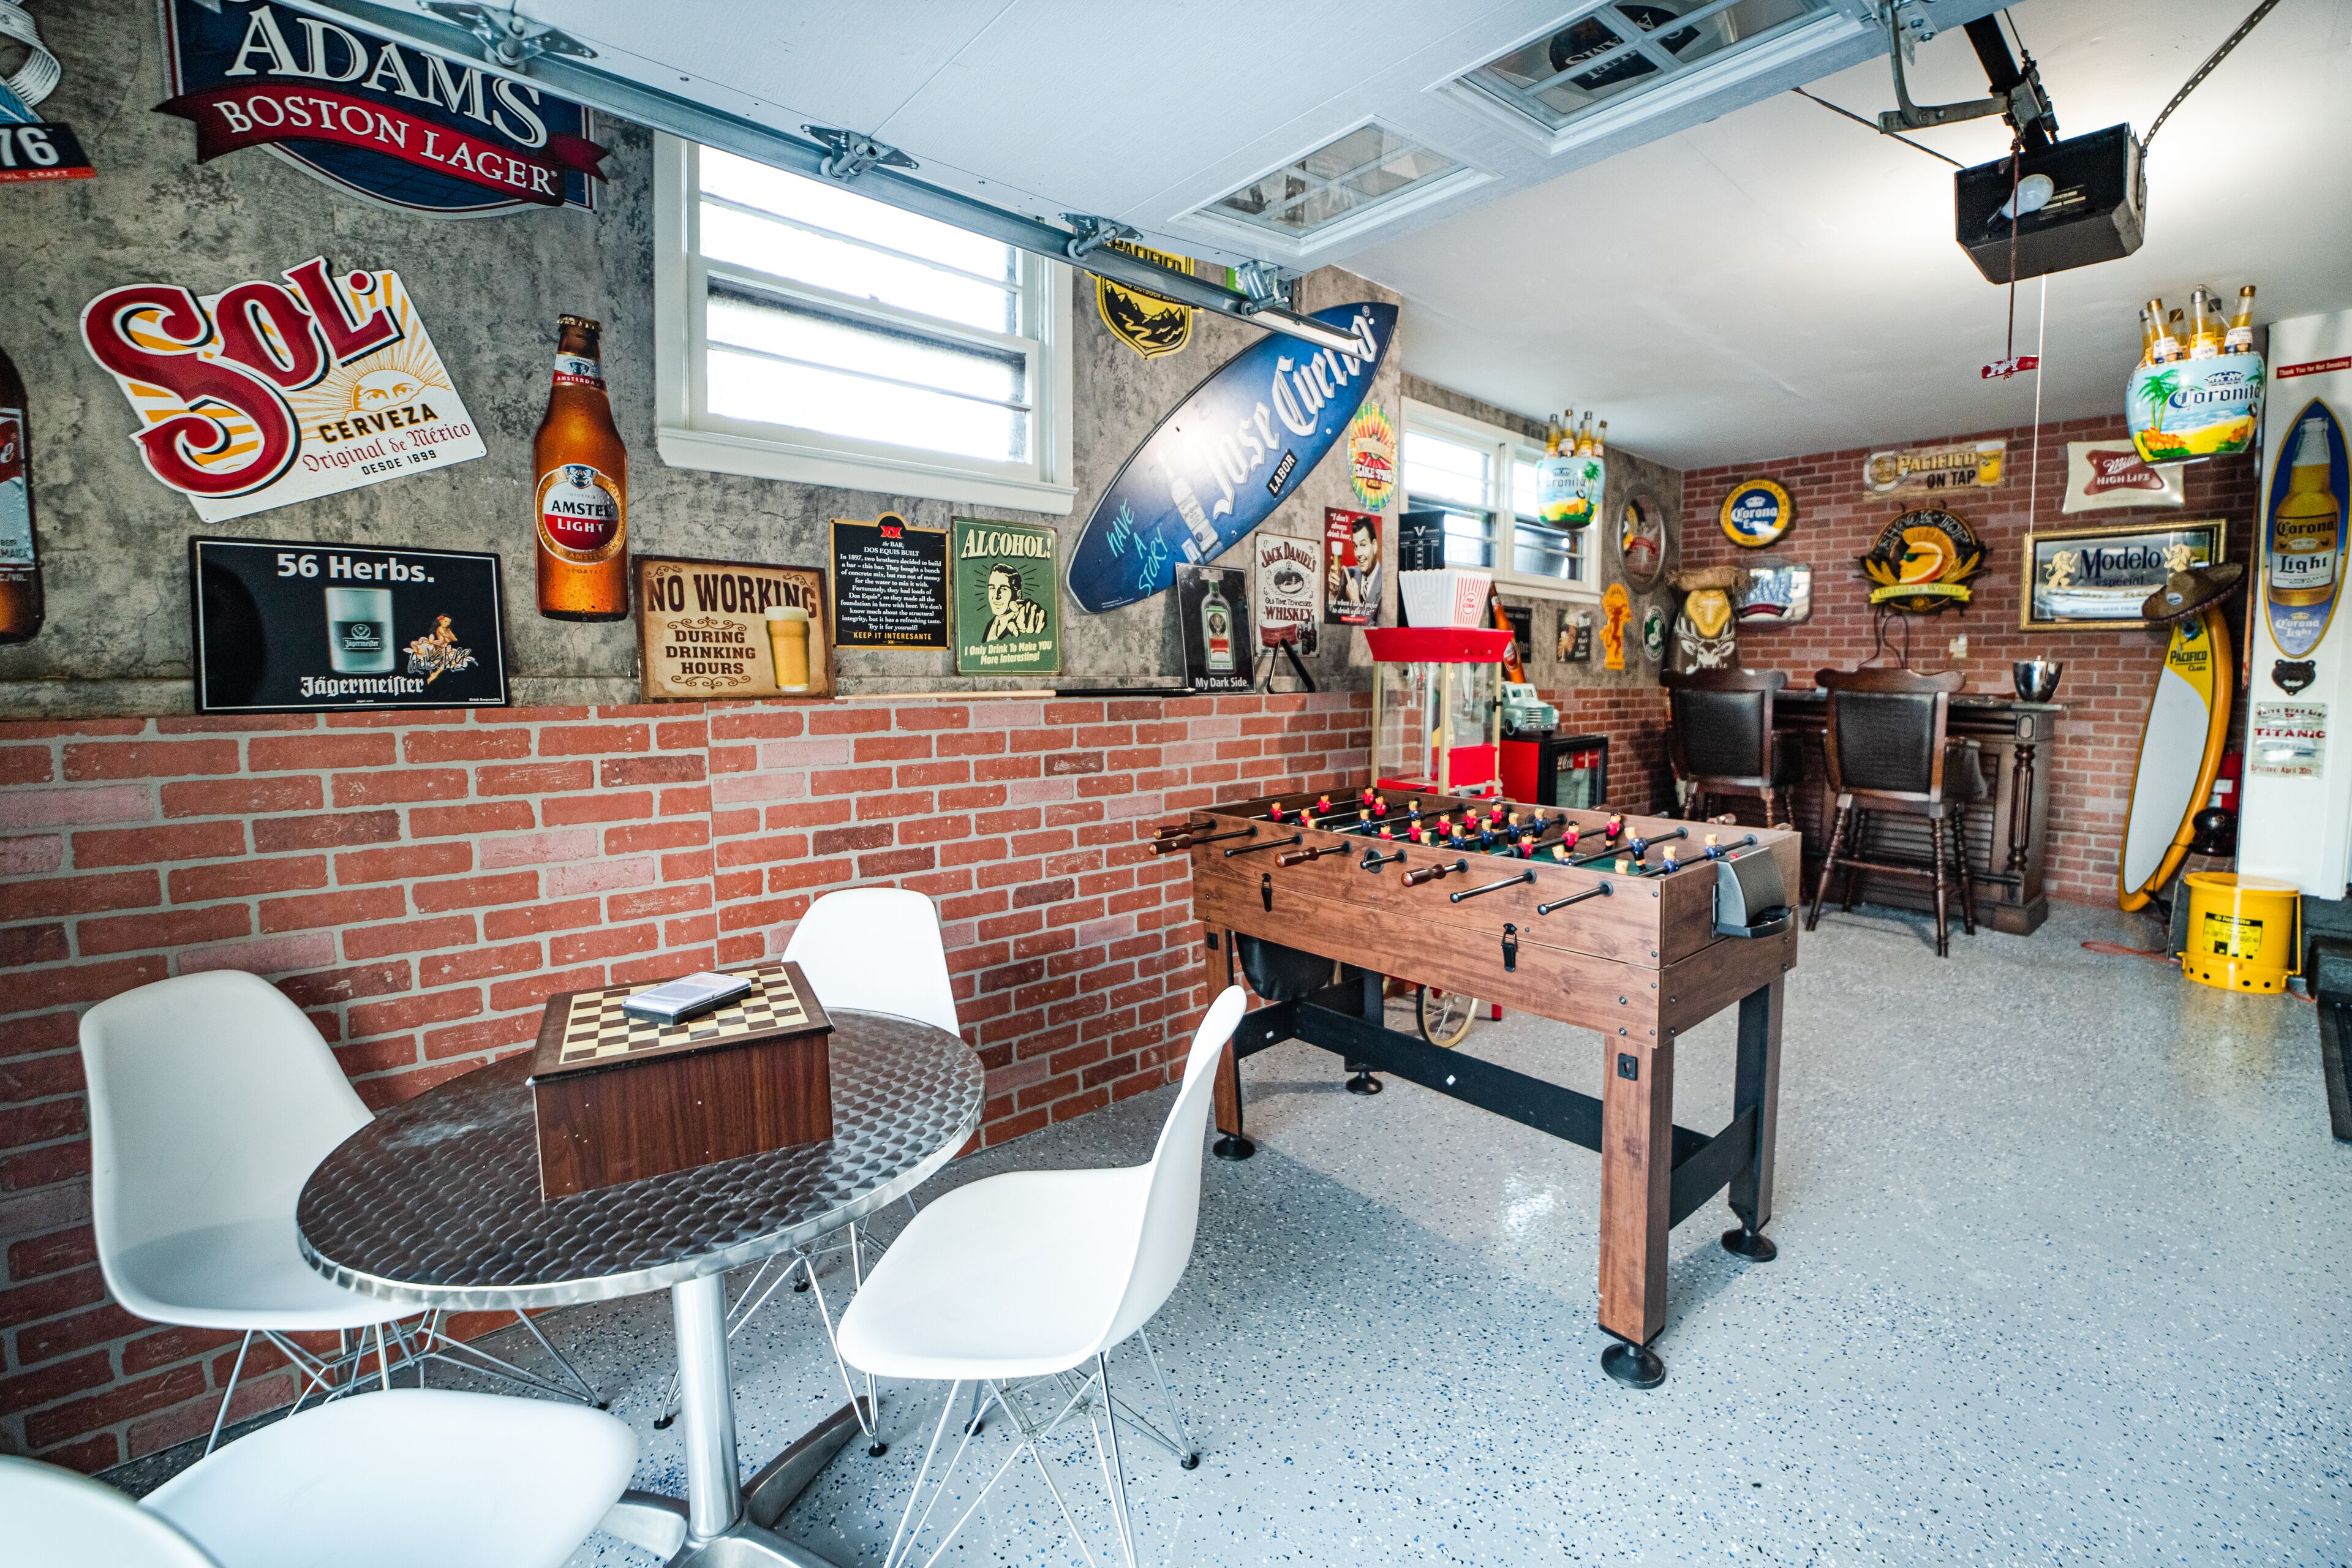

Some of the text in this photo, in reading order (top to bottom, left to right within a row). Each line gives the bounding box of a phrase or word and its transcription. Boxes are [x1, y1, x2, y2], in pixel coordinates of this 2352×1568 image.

[224, 4, 547, 149] ADAMS
[212, 96, 410, 149] BOSTON
[1134, 285, 1162, 299] OUTDOOR
[2278, 368, 2295, 377] Thank
[2296, 366, 2306, 374] You
[2326, 360, 2350, 370] Smoking
[86, 260, 399, 494] SOL
[2169, 383, 2261, 411] Coronita
[318, 403, 440, 444] CERVEZA
[1212, 314, 1377, 521] Jose Cuervo
[302, 422, 471, 473] Original de México
[361, 450, 437, 476] DESDE 1899
[1896, 453, 1976, 475] PACIFICO
[1270, 454, 1296, 495] LABOR
[1355, 463, 1392, 483] TAKE TWO
[1926, 470, 1977, 489] ON TAP
[2097, 473, 2151, 485] HIGH LIFE
[551, 500, 612, 517] AMSTEL
[1730, 507, 1778, 523] Corona
[557, 518, 605, 533] LIGHT
[1336, 514, 1349, 522] don't
[880, 525, 902, 539] XX
[1106, 498, 1134, 557] HAVE
[1331, 522, 1348, 532] always
[1878, 511, 1971, 550] SHOCK TOP
[2276, 521, 2335, 537] Corona
[960, 529, 1052, 559] ALCOHOL!
[1134, 532, 1147, 559] A
[1139, 526, 1168, 597] STORY
[1259, 540, 1317, 573] JACK DANIEL'S
[2079, 545, 2162, 579] Modelo
[2278, 554, 2328, 573] Light
[276, 554, 435, 583] 56 Herbs.
[1927, 584, 1962, 594] WHITE
[2095, 577, 2144, 588] especial
[647, 573, 818, 619] NO WORKING
[1287, 598, 1313, 608] TENNESSEE
[1264, 606, 1314, 622] WHISKEY
[2275, 619, 2320, 630] Corona
[2286, 627, 2312, 638] Light
[674, 630, 745, 644] DURING
[665, 646, 756, 659] DRINKING
[965, 641, 1052, 656] I Only Drink To Make YOU
[981, 652, 1039, 665] More Interesting!
[2169, 650, 2207, 664] PACIFICO
[681, 662, 745, 674] HOURS
[1195, 677, 1250, 690] My Dark Side.
[2308, 709, 2327, 718] LINE
[2254, 728, 2326, 739] TITANIC
[2280, 766, 2297, 775] April
